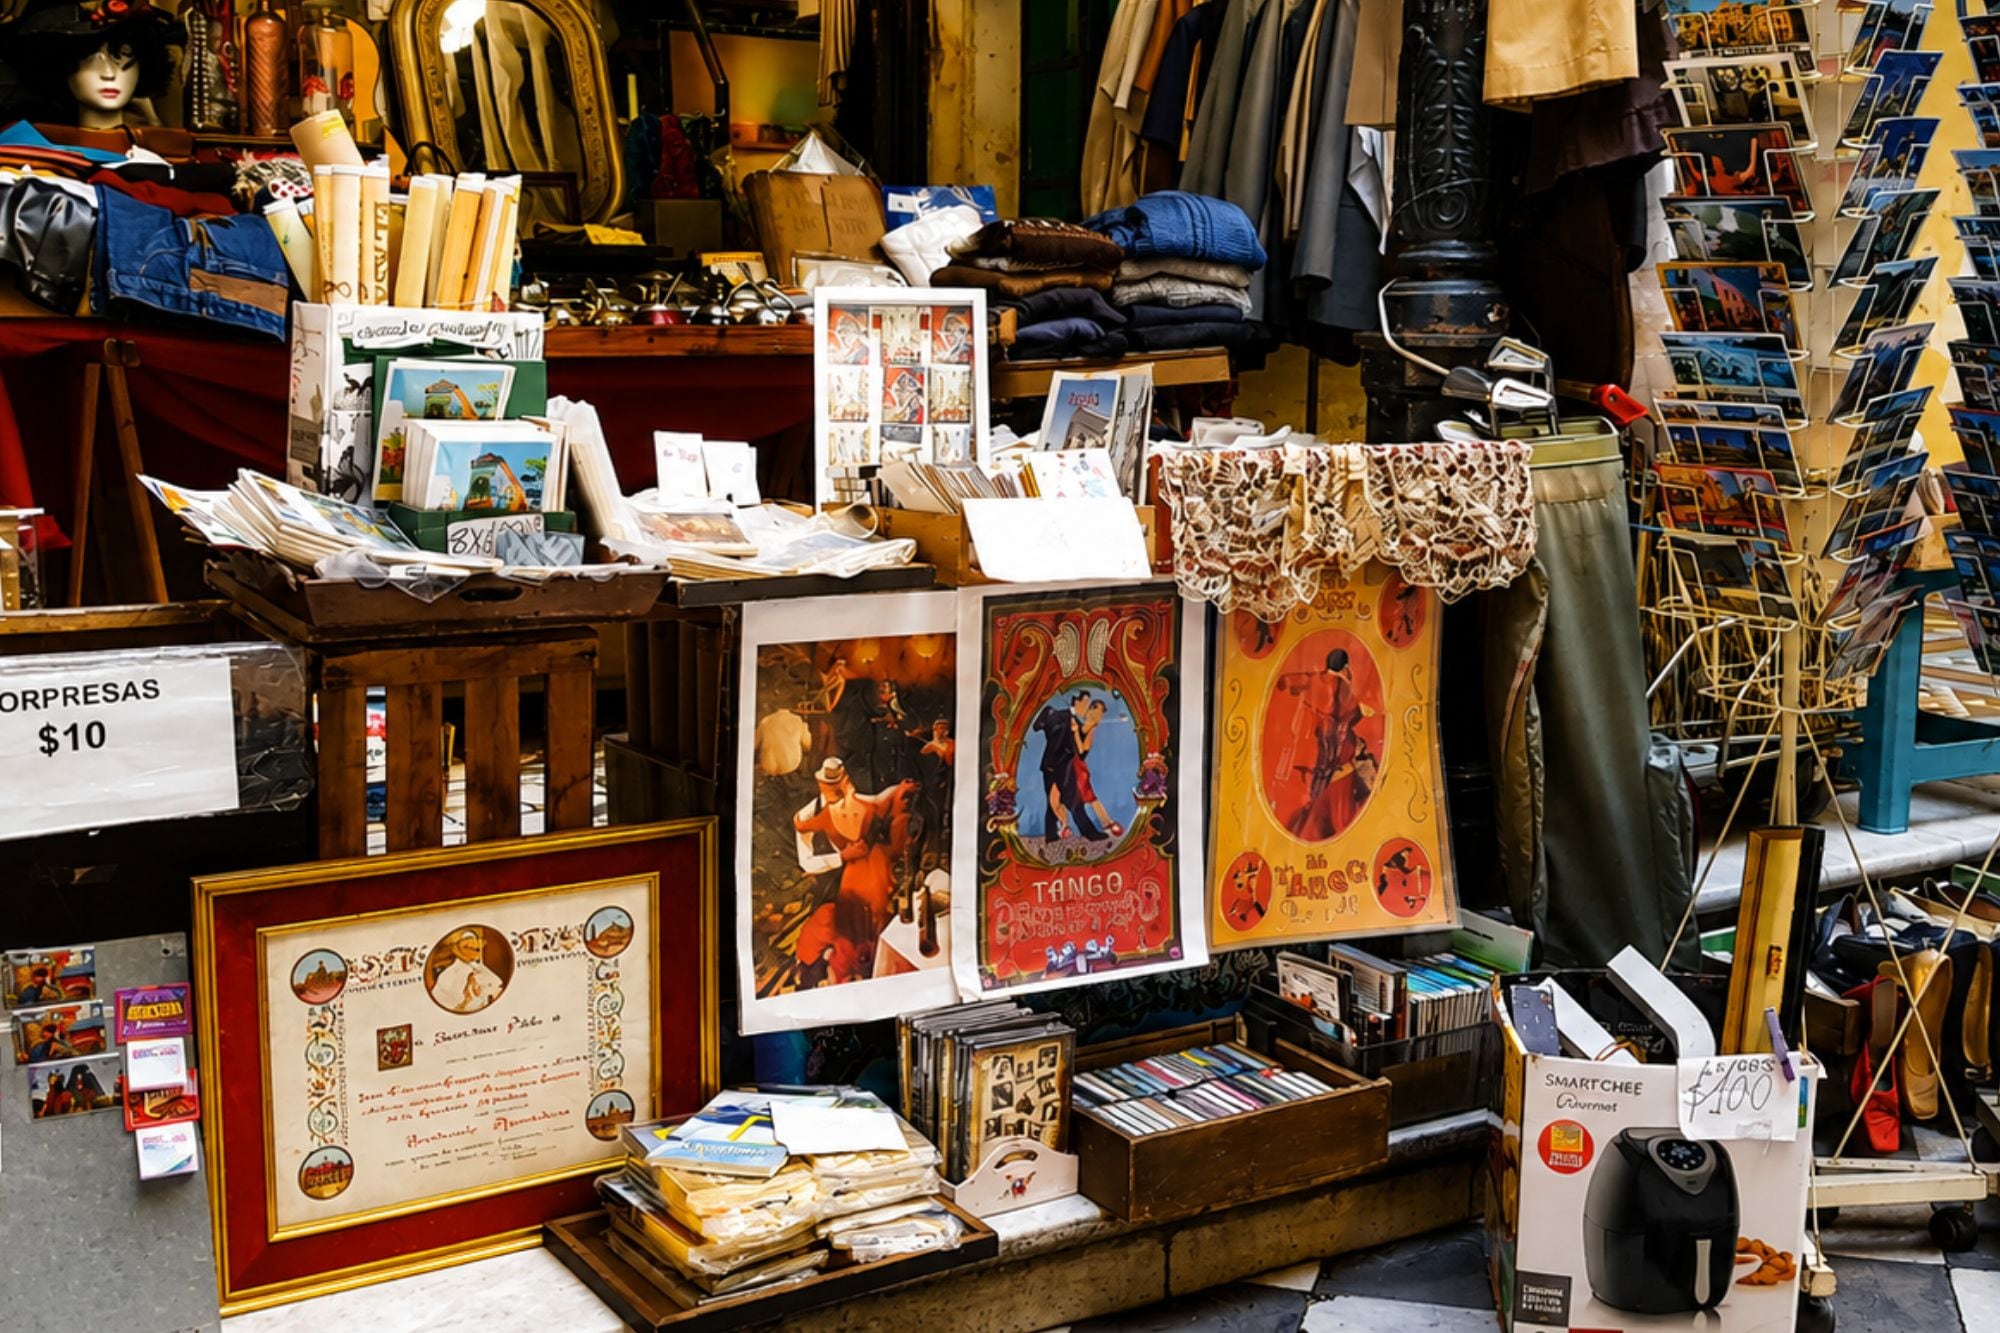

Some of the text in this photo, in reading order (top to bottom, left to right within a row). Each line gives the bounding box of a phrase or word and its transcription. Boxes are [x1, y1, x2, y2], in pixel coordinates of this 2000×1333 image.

[0, 679, 160, 713] ORPRESAS
[38, 720, 107, 757] $10
[1032, 871, 1124, 903] TANGO
